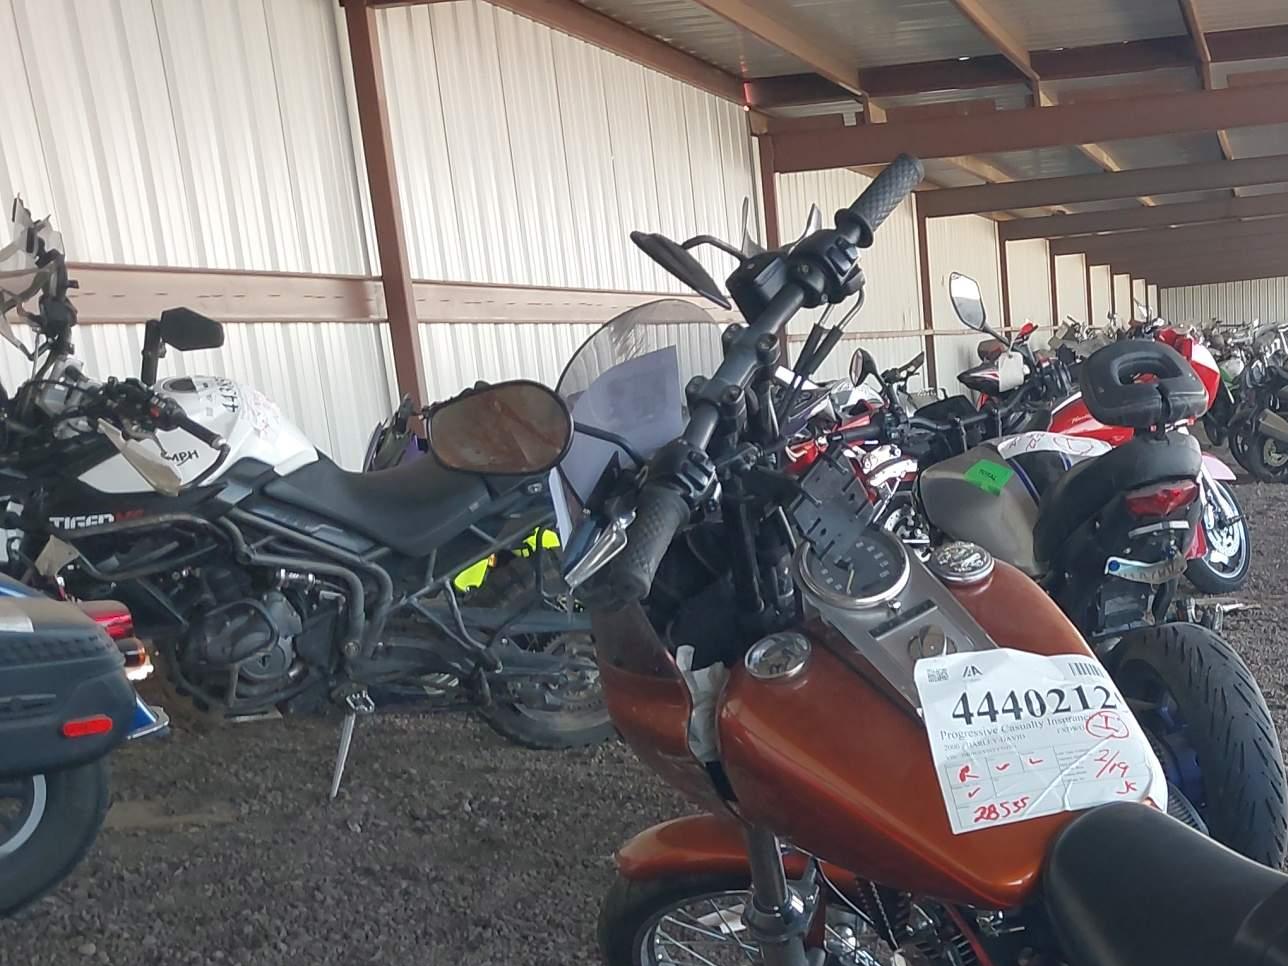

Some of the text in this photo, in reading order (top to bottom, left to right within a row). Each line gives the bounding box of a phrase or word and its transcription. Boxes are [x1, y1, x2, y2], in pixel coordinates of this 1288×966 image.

[952, 684, 1122, 725] 4440212
[940, 714, 1090, 741] Progressive Casualty Insuranc
